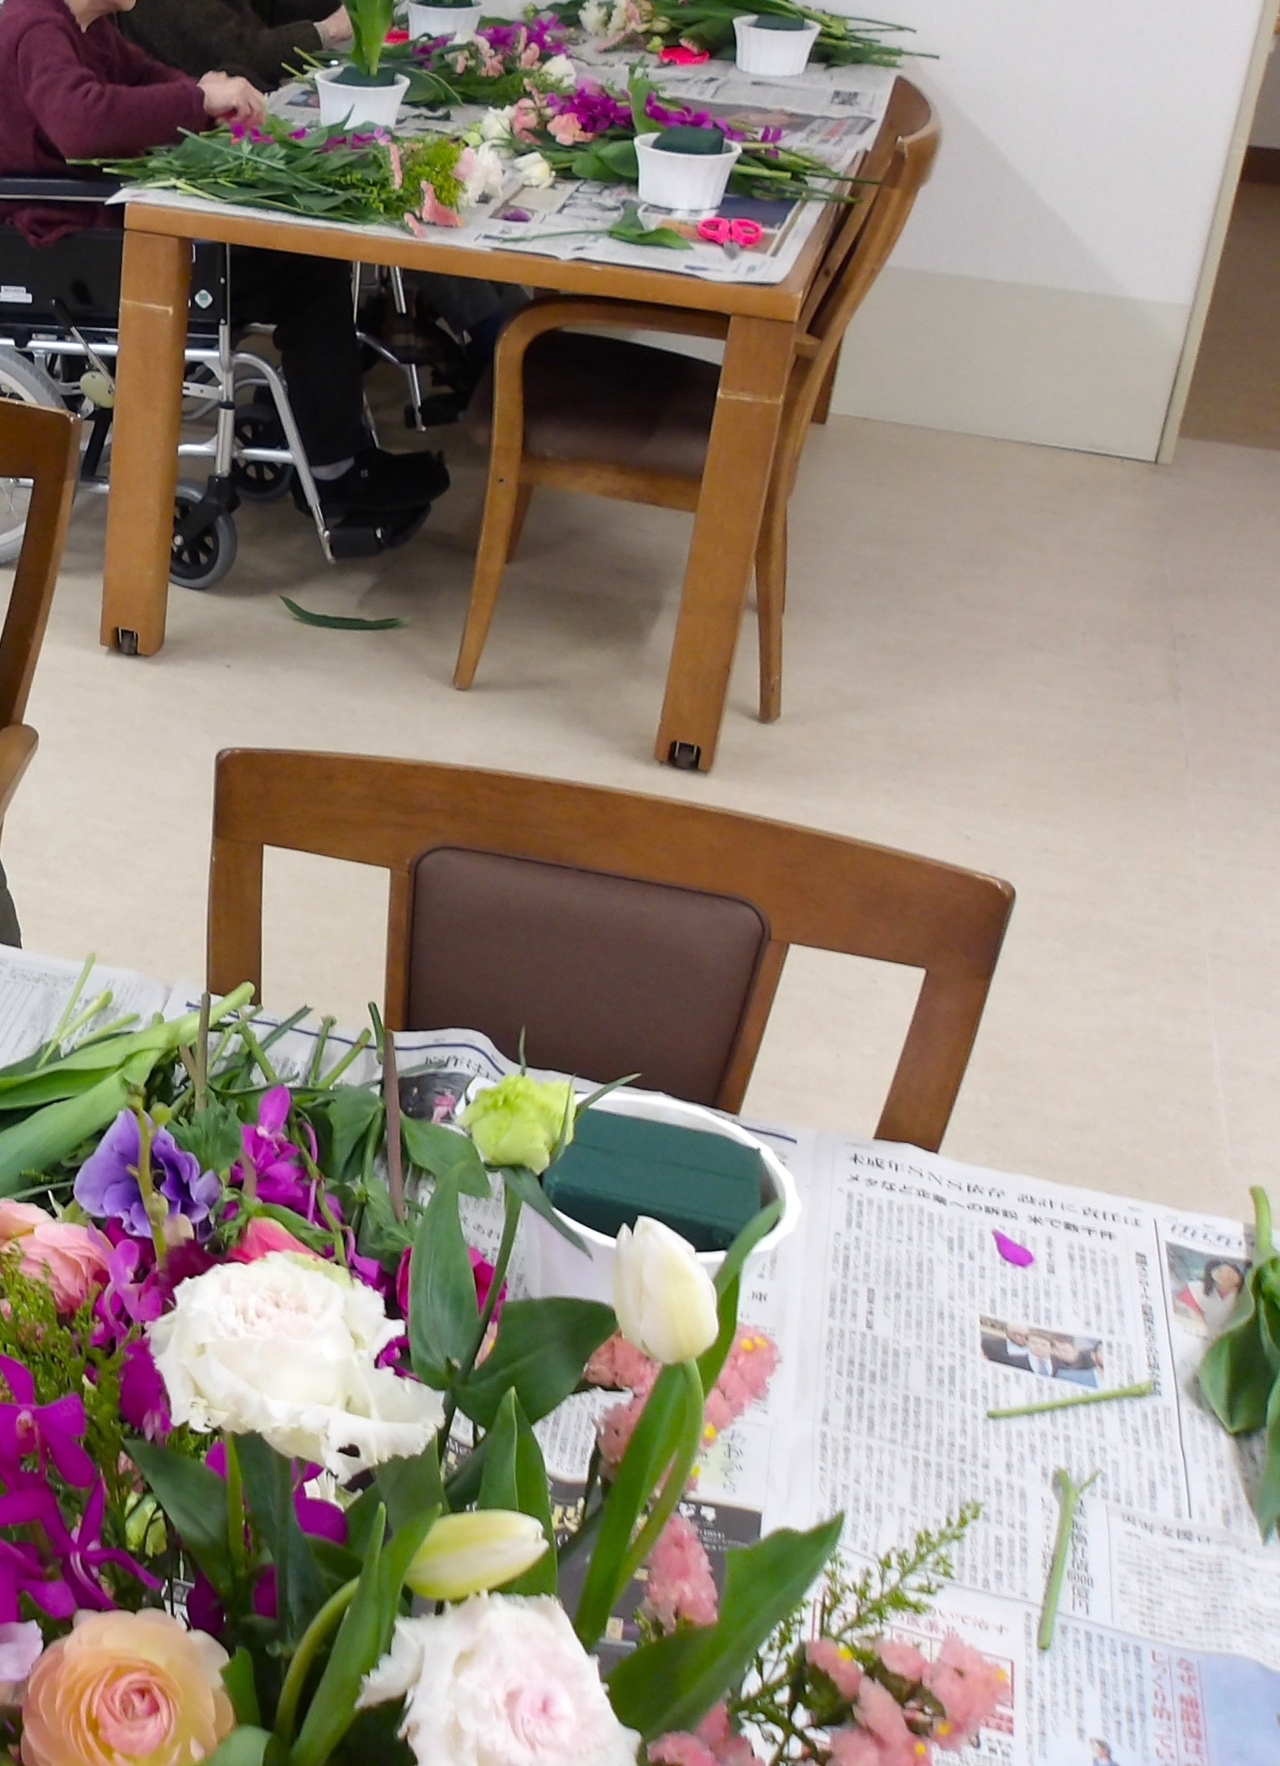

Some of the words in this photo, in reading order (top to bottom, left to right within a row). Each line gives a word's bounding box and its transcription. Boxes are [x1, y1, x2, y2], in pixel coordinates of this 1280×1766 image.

[849, 1152, 1008, 1199] 未成年SNS依存
